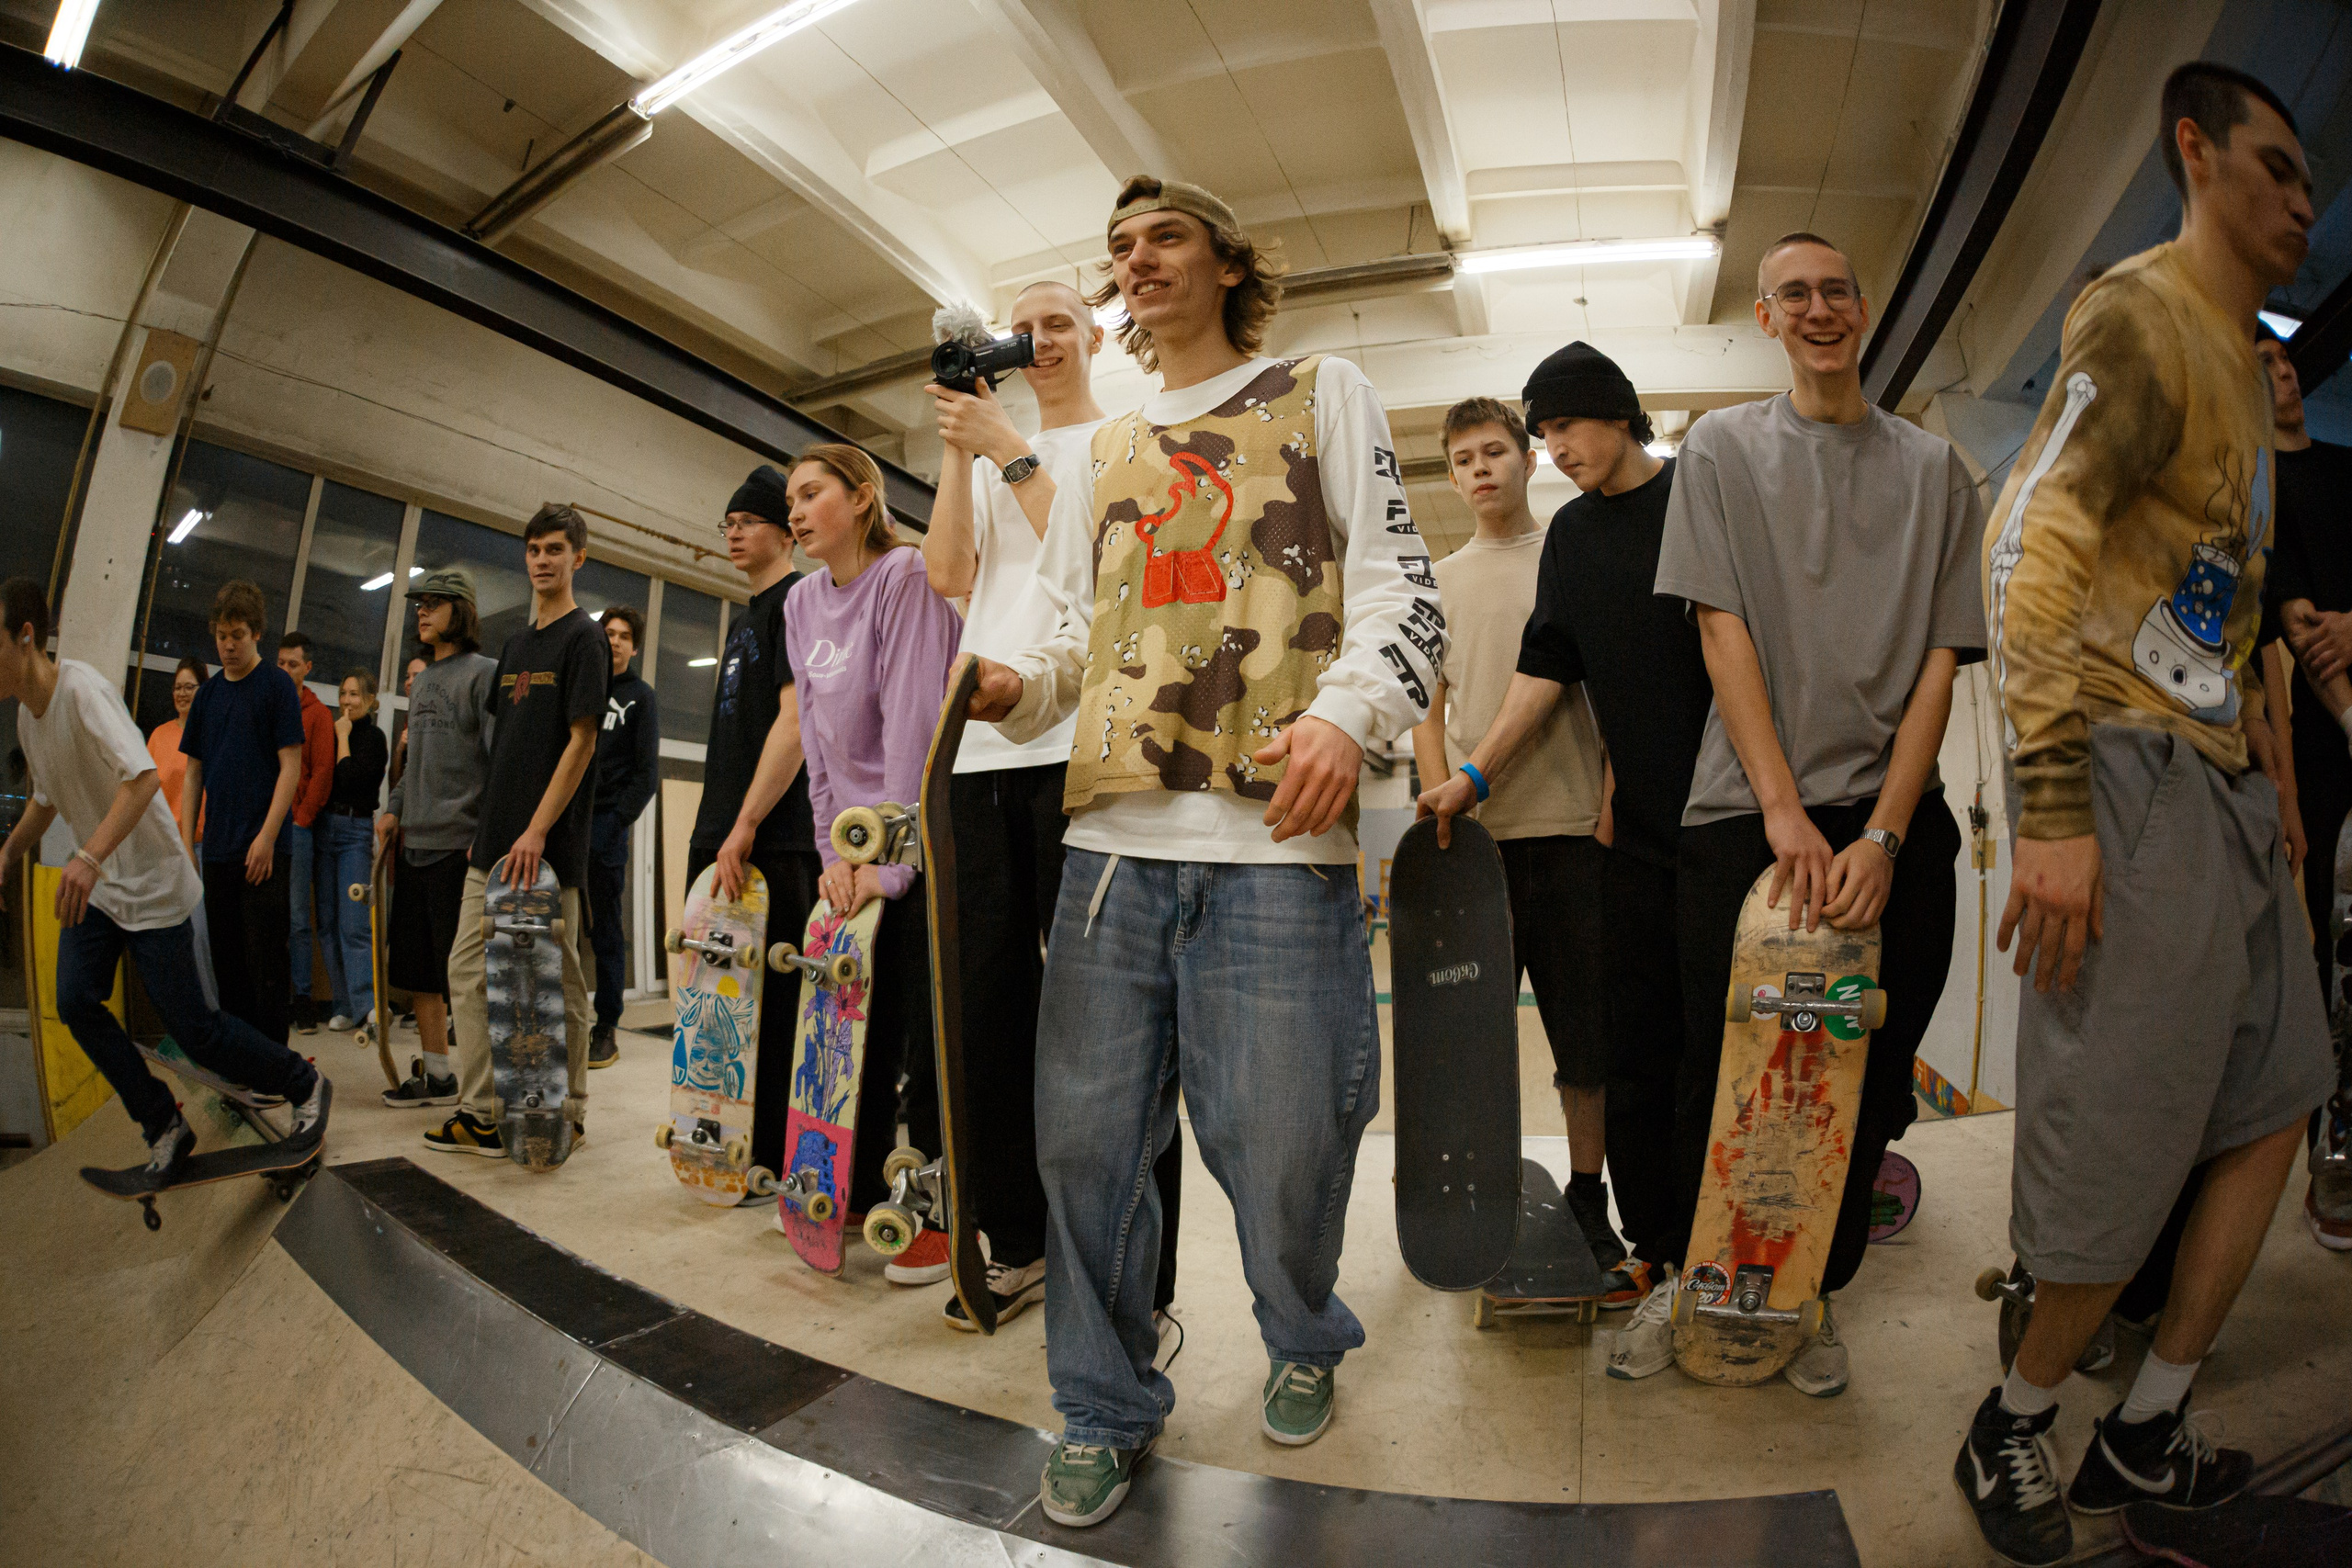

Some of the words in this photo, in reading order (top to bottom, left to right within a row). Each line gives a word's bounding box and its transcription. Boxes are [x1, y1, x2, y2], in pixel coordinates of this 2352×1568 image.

[1397, 556, 1430, 577] FT
[1411, 575, 1438, 587] VIDE
[1378, 643, 1430, 709] FTP
[1698, 1292, 1714, 1304] 20
